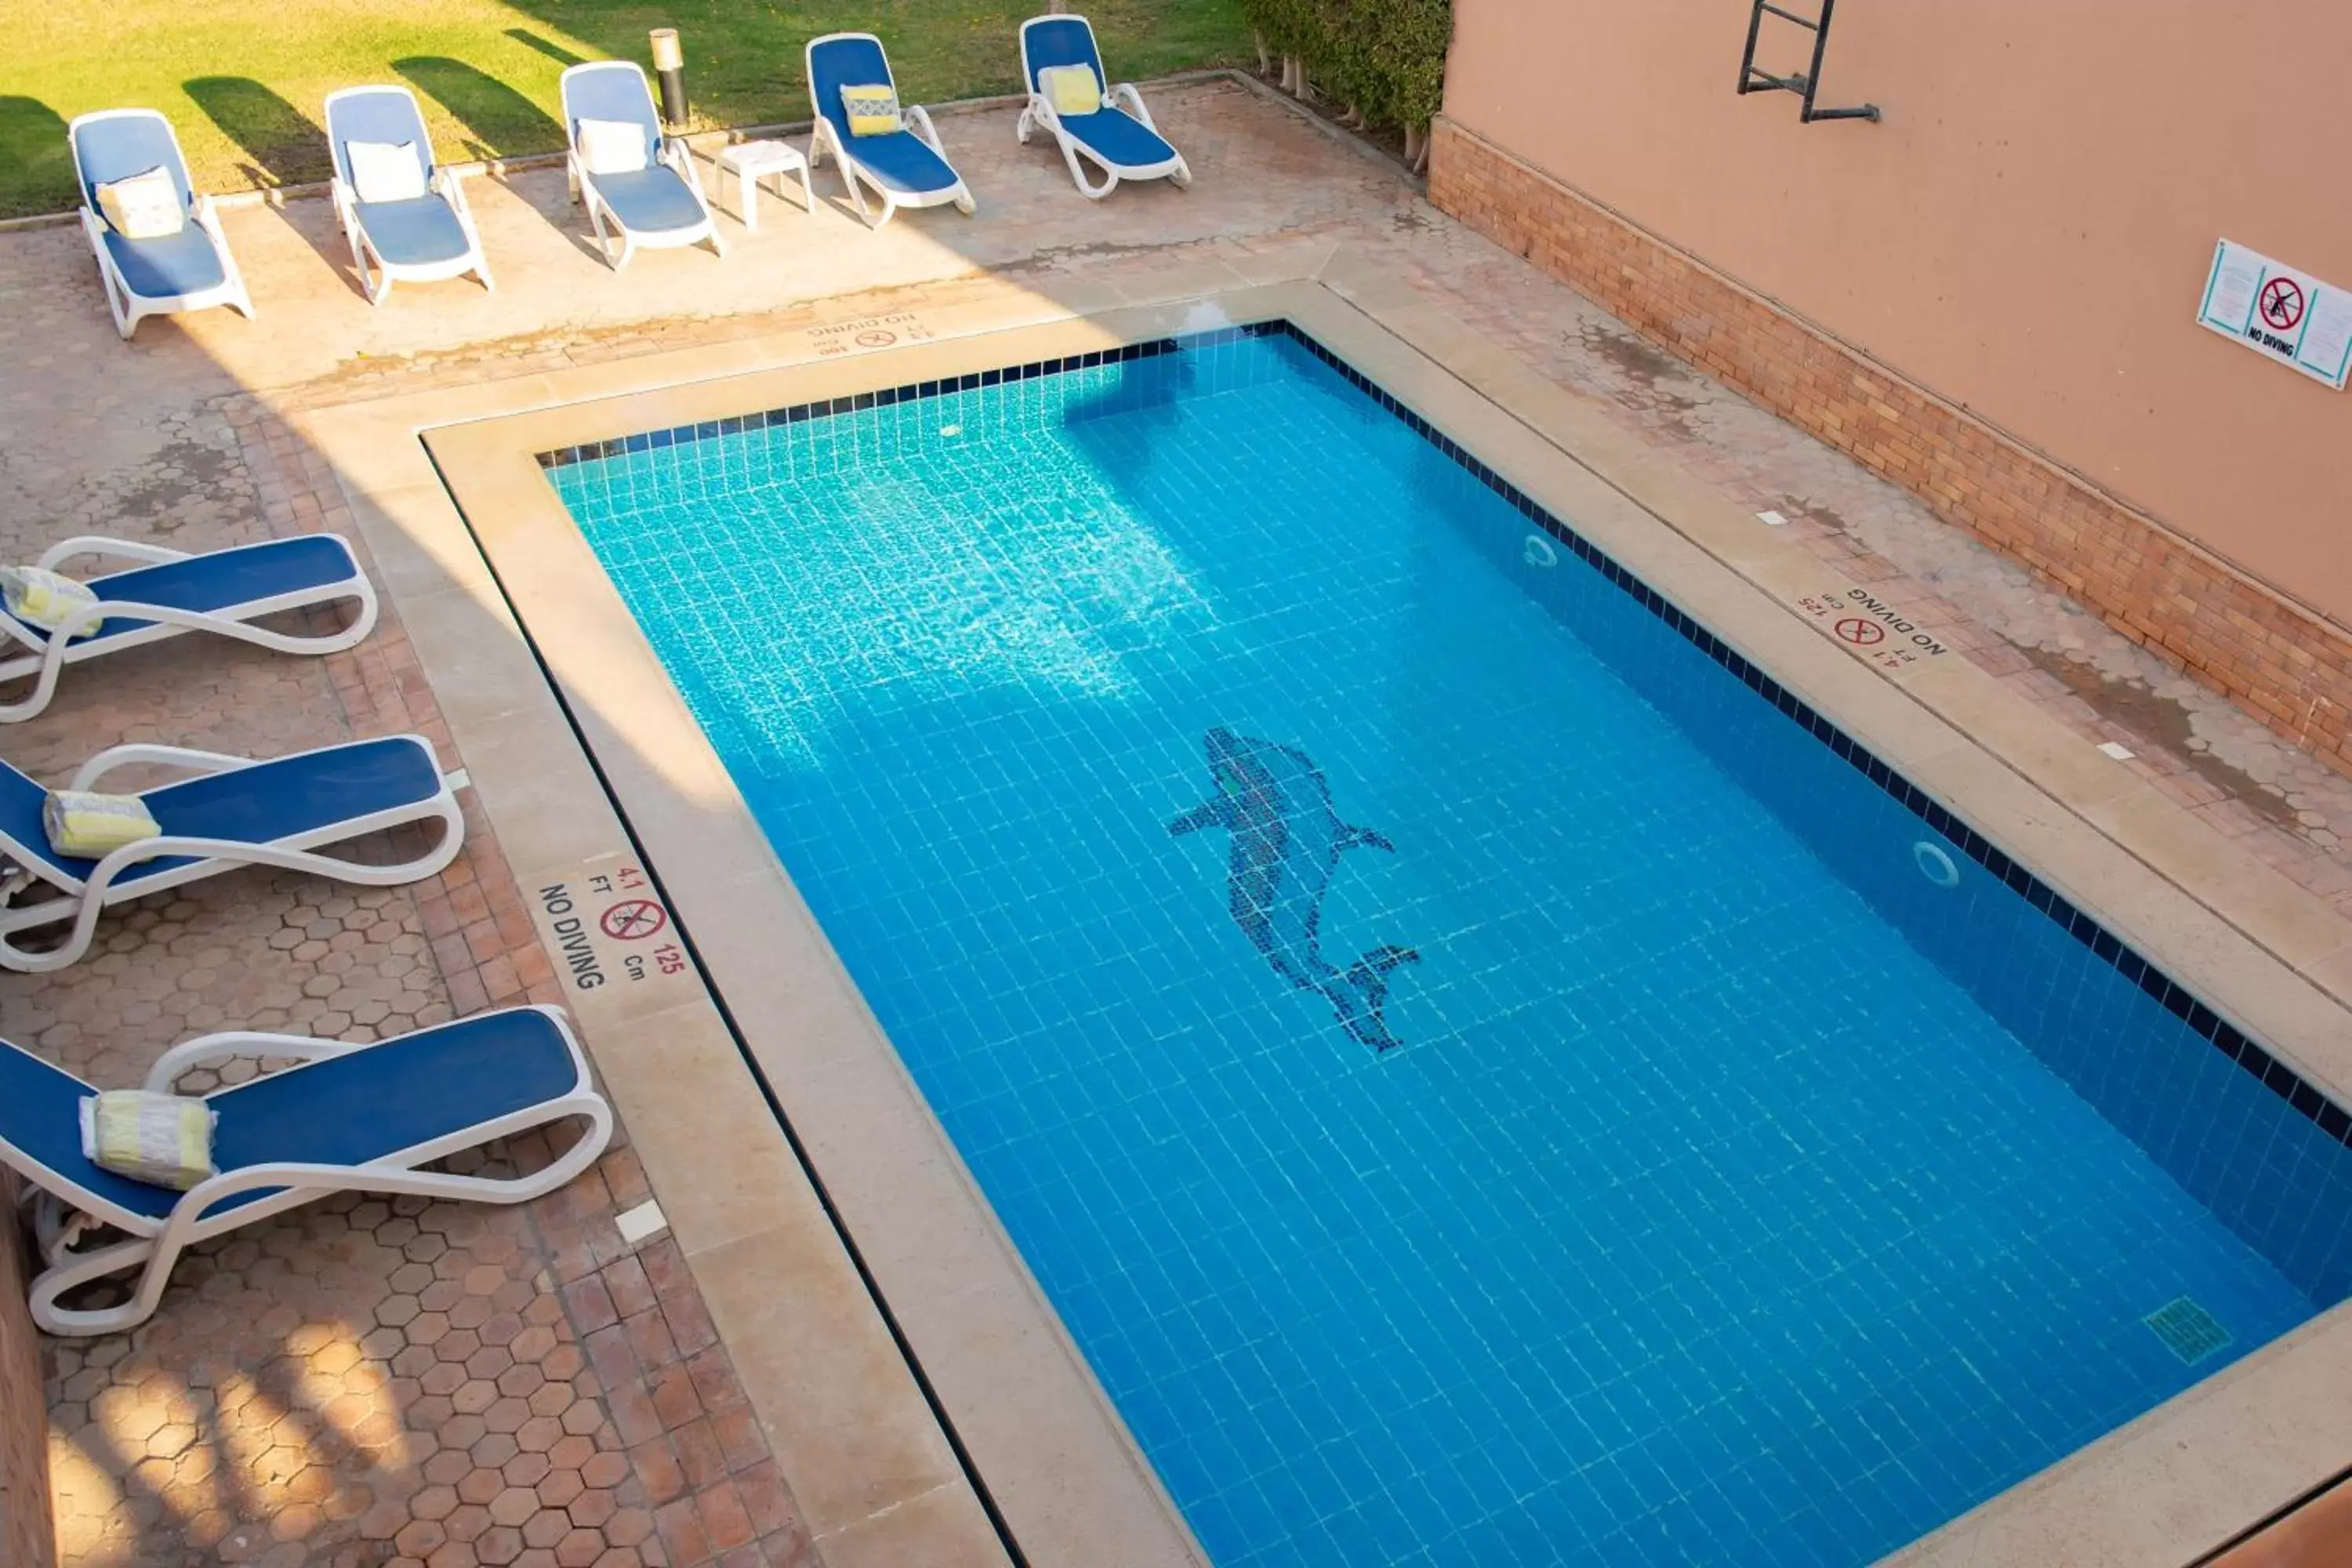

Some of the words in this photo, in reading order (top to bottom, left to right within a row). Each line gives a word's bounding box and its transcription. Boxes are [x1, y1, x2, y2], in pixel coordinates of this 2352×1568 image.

[808, 319, 879, 337] DIVING
[885, 314, 916, 324] NO
[2248, 326, 2262, 342] NO
[2263, 332, 2294, 357] DIVING
[1798, 597, 1828, 618] 125
[1847, 589, 1915, 633] DIVING
[1893, 649, 1917, 662] FT
[1911, 634, 1947, 656] NO
[589, 874, 612, 893] FT
[617, 868, 645, 890] 4.1
[539, 884, 573, 915] NO
[554, 917, 604, 989] DIVING
[653, 943, 686, 975] 125
[624, 955, 645, 981] Cm
